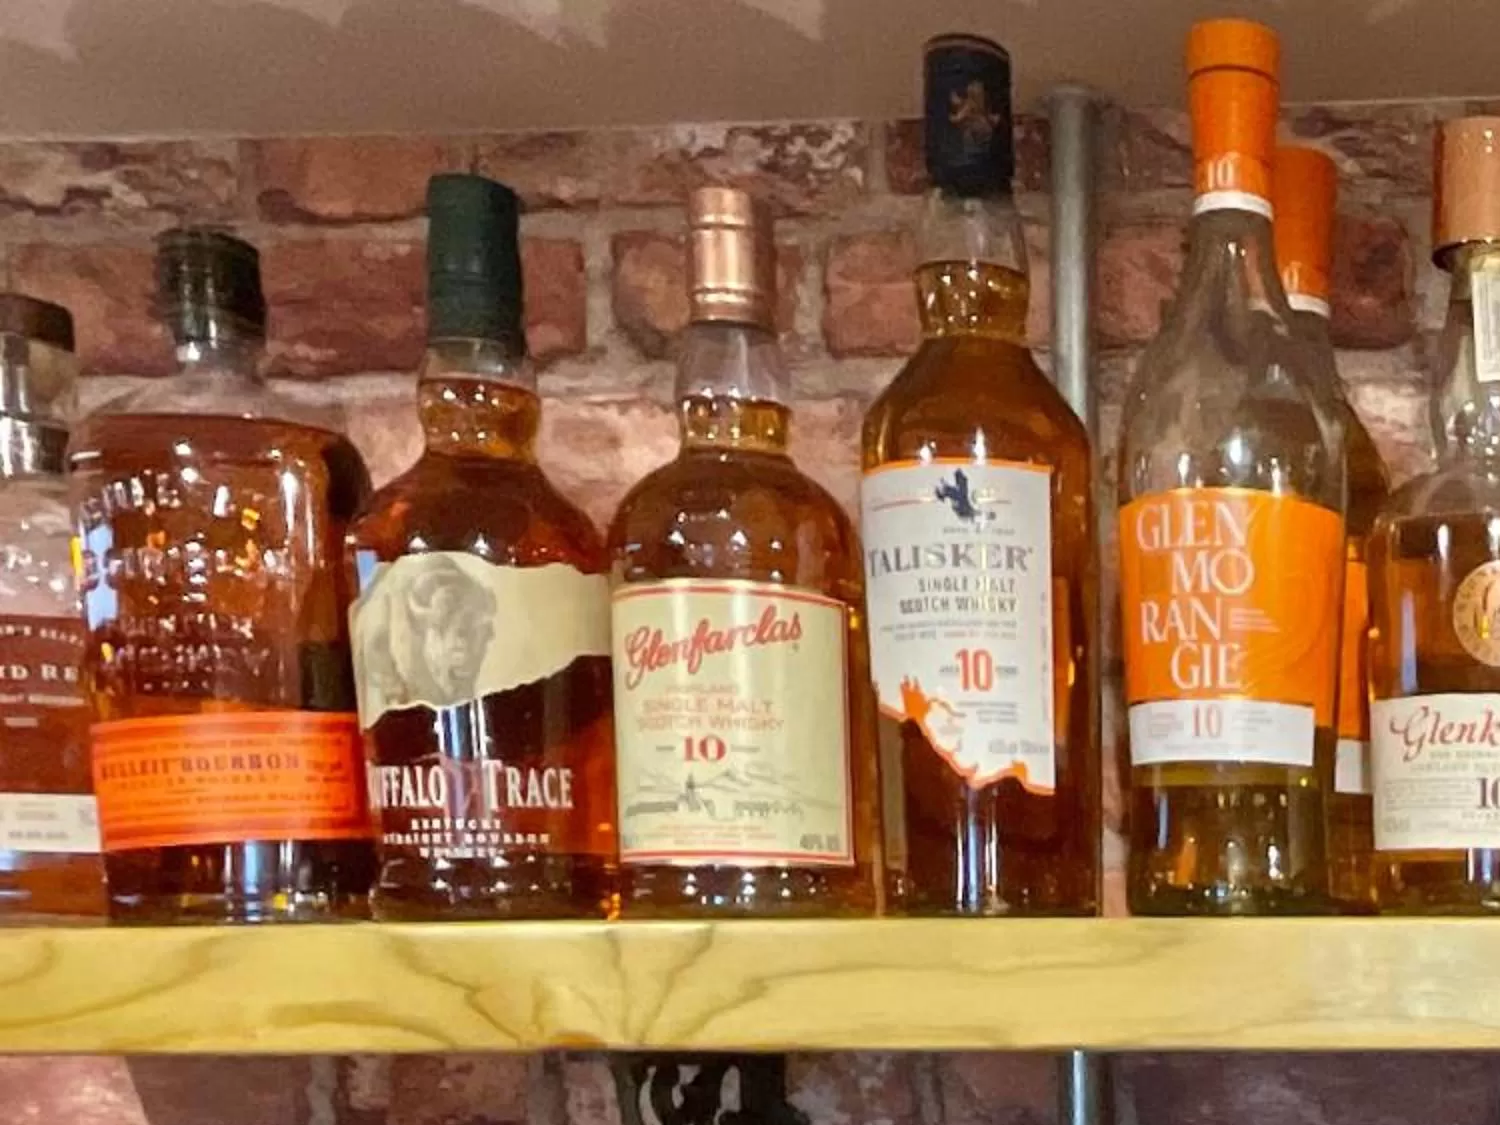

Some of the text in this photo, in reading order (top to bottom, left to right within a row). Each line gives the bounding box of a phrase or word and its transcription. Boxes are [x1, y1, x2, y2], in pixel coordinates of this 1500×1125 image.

[1136, 499, 1254, 551] GLEN
[868, 543, 1031, 577] TALISKER
[1171, 549, 1255, 596] MO
[1140, 596, 1223, 644] RAN
[624, 604, 804, 690] Glenfarclas
[955, 648, 994, 691] 10
[1171, 644, 1244, 689] GIE
[1190, 704, 1223, 738] 10
[683, 735, 727, 762] 10
[366, 760, 448, 809] UFFALO
[481, 759, 574, 812] TRACE
